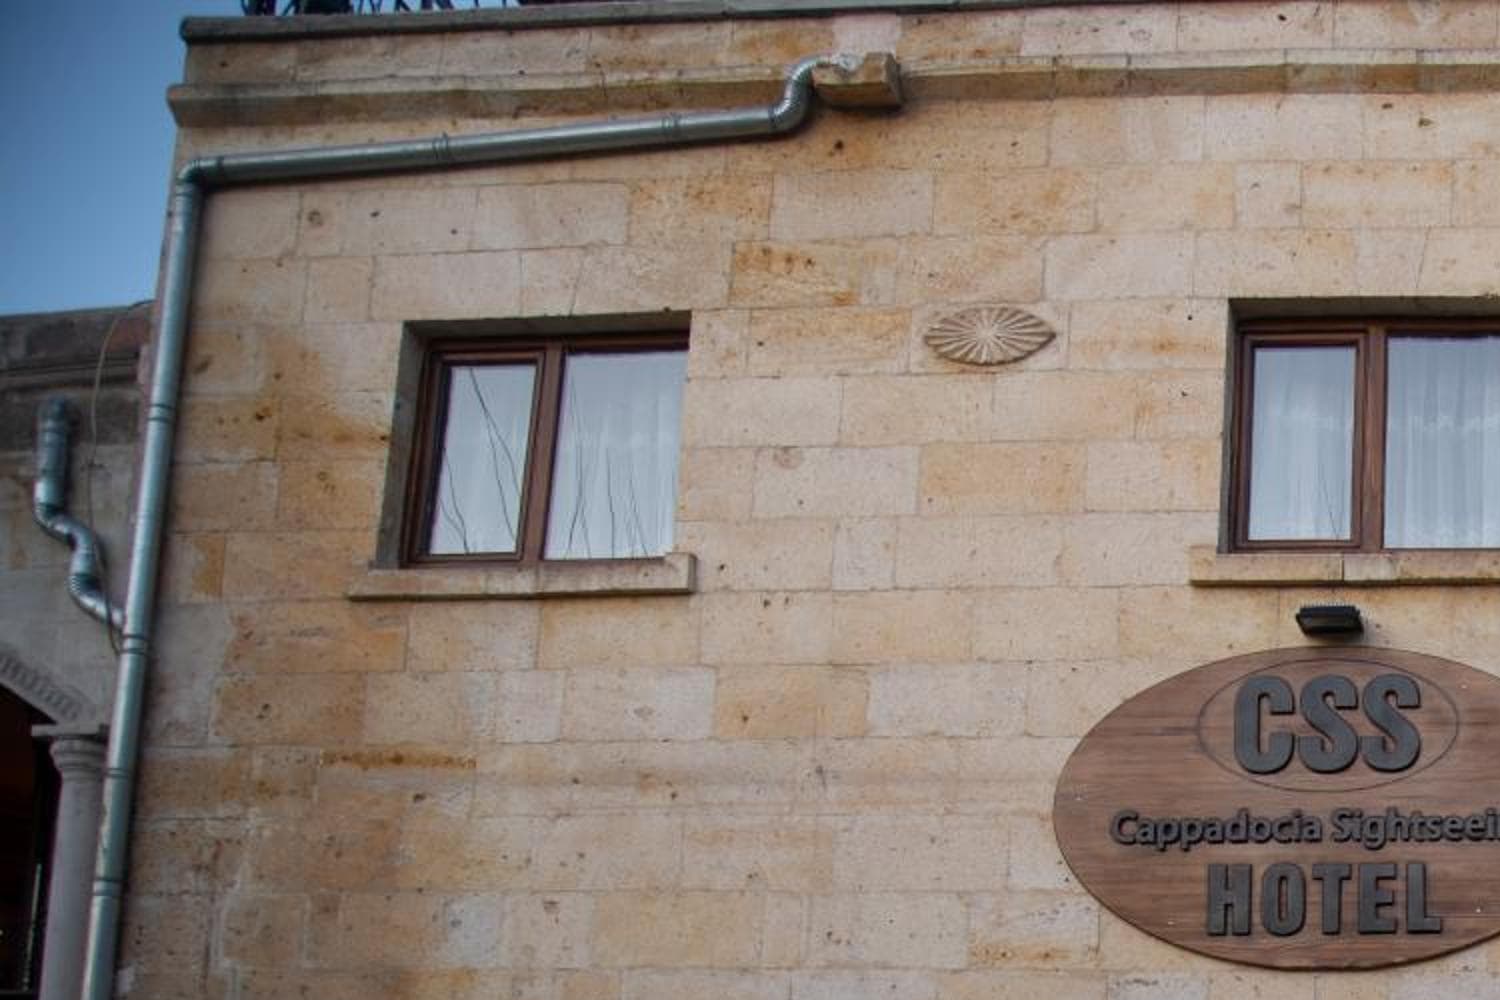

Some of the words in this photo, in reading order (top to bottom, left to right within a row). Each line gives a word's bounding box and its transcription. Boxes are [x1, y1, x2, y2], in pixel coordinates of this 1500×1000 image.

[1234, 674, 1421, 774] CSS
[1113, 811, 1323, 851] Cappadocia
[1206, 862, 1444, 937] HOTEL
